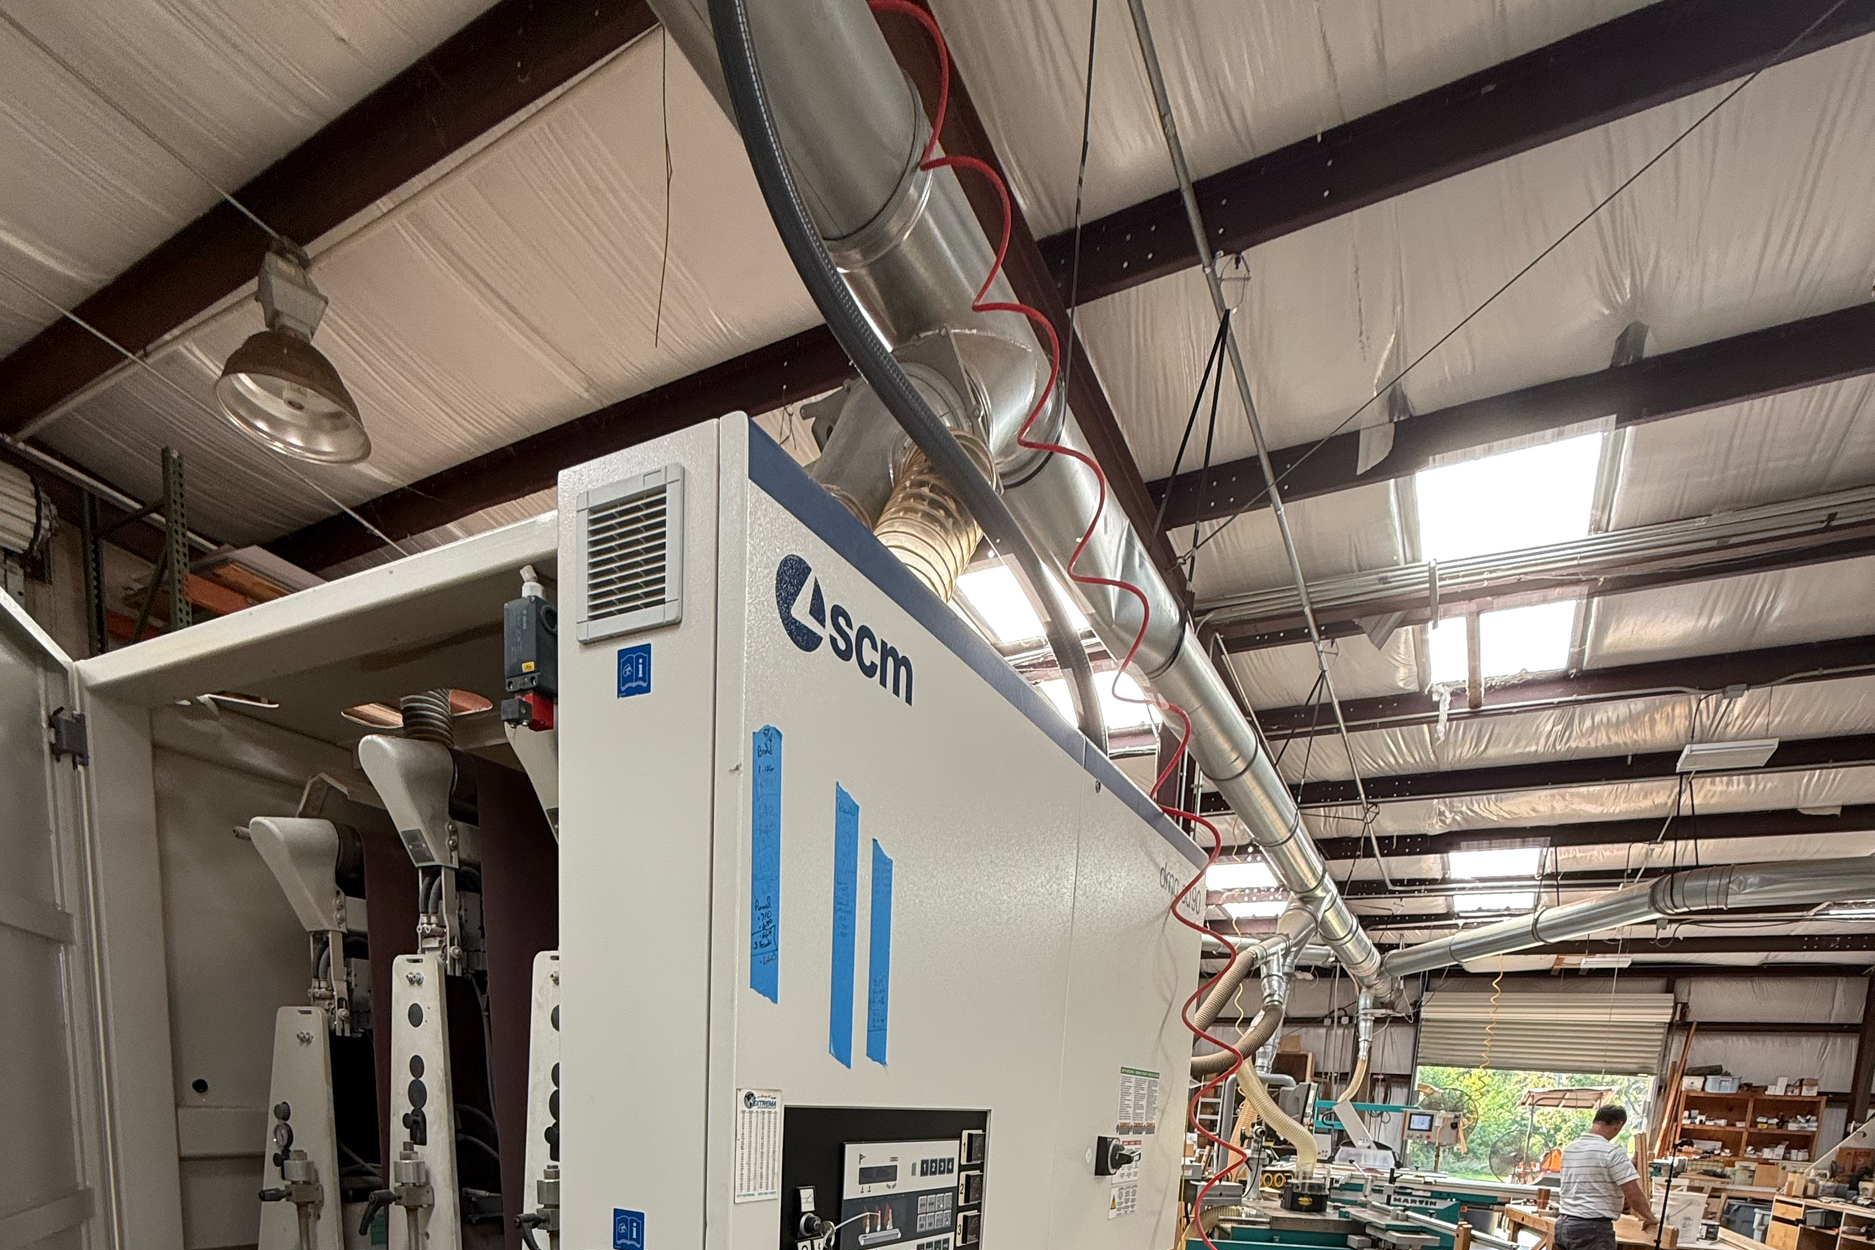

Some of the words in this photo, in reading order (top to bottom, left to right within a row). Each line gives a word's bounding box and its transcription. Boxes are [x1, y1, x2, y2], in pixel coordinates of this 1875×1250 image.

[829, 603, 913, 707] scm
[754, 1100, 777, 1108] EXTREMA
[1393, 1197, 1437, 1206] MARTIN
